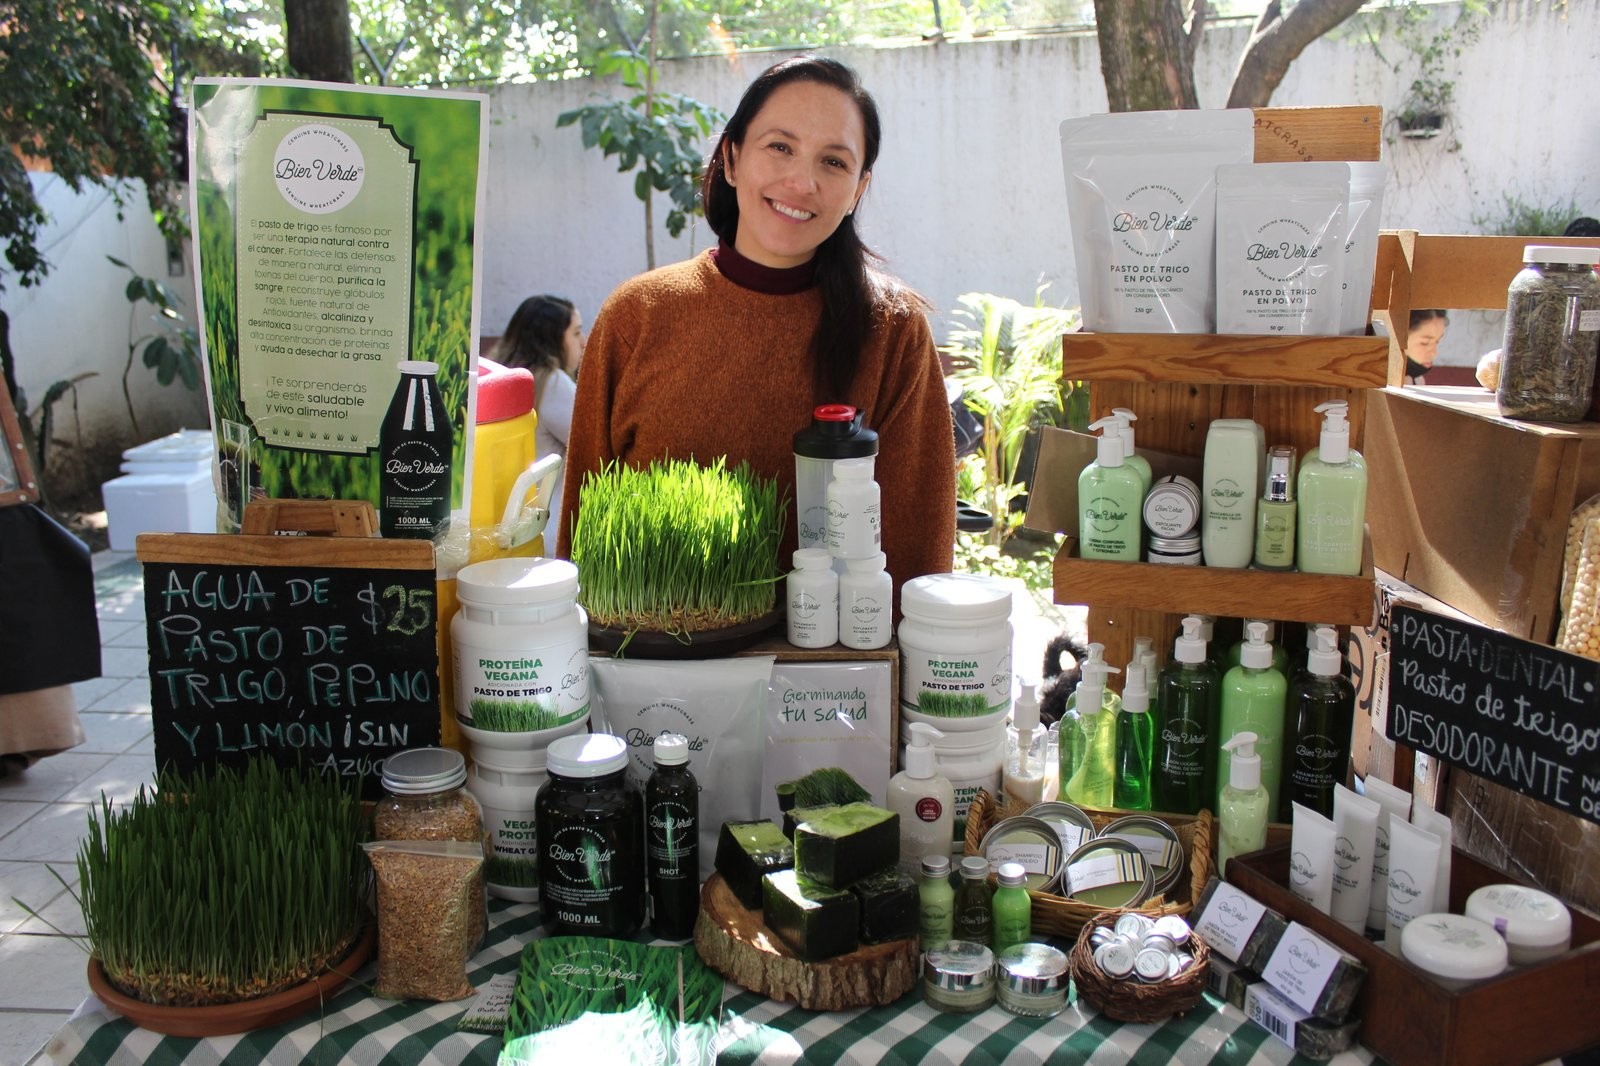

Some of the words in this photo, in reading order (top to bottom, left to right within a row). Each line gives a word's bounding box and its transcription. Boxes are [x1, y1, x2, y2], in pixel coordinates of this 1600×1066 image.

[1254, 118, 1313, 162] ATGRASS
[276, 158, 312, 180] Bien
[312, 159, 358, 181] Verde
[258, 220, 281, 230] pasto
[283, 221, 295, 230] de
[297, 222, 319, 232] trigo
[334, 224, 371, 235] famoso
[373, 227, 392, 236] por
[1113, 212, 1148, 232] Bien
[1149, 211, 1192, 231] Verde
[253, 233, 265, 241] ser
[285, 234, 318, 245] terapia
[320, 237, 355, 247] natural
[357, 239, 389, 249] contra
[289, 247, 332, 258] Fortalece
[334, 250, 348, 260] las
[350, 251, 396, 262] defensas
[1246, 243, 1280, 261] Bien
[258, 258, 269, 266] de
[271, 259, 306, 269] manera
[346, 263, 381, 274] elimina
[1110, 265, 1139, 273] PASTO
[1142, 265, 1156, 273] DE
[254, 269, 282, 280] toxinas
[283, 270, 297, 281] del
[337, 275, 374, 287] purifica
[376, 278, 386, 286] la
[1124, 275, 1136, 283] EN
[1139, 275, 1172, 283] POLVO
[286, 284, 341, 297] reconstruye
[289, 298, 317, 308] fuente
[319, 300, 354, 310] natural
[356, 301, 370, 311] de
[321, 312, 366, 323] alcaliniza
[368, 316, 374, 324] y
[248, 318, 291, 330] desintoxica
[292, 323, 302, 331] su
[360, 327, 392, 337] brinda
[249, 330, 264, 340] alta
[265, 332, 326, 345] concentración
[328, 336, 341, 346] de
[254, 344, 259, 352] y
[260, 344, 285, 354] ayuda
[295, 346, 338, 358] desechar
[340, 350, 350, 359] la
[352, 353, 383, 361] grasa.
[286, 379, 367, 394] sorprenderás
[266, 390, 280, 399] de
[282, 391, 305, 402] este
[307, 394, 364, 407] saludable
[266, 404, 272, 413] y
[274, 404, 294, 414] vivo
[297, 407, 348, 420] alimento!
[386, 460, 413, 474] Bien
[413, 460, 445, 474] Verde
[161, 570, 276, 611] AGUA
[286, 578, 330, 606] DE
[357, 582, 433, 635] $25
[157, 614, 283, 663] PASTO
[302, 625, 348, 655] DE
[479, 658, 543, 670] PROTEÍNA
[928, 660, 979, 669] PROTEÍNA
[484, 671, 539, 681] VEGANA
[932, 669, 975, 678] VEGANA
[307, 663, 430, 707] PEPINO
[474, 687, 504, 697] PASTO
[506, 689, 520, 697] DE
[522, 686, 552, 696] TRIGO
[922, 681, 947, 690] PASTO
[783, 686, 866, 703] Germinando
[782, 705, 806, 722] tu
[814, 701, 867, 722] salud
[1476, 683, 1505, 721] de
[1513, 694, 1600, 756] trigo
[172, 721, 200, 757] Y
[216, 709, 332, 752] LIMÓN
[1395, 704, 1574, 807] DESODORANTE
[503, 819, 536, 829] VEGA
[494, 845, 527, 854] WHEAT
[550, 844, 576, 862] Bien
[557, 910, 581, 924] 1000
[584, 915, 601, 924] ML
[550, 963, 591, 976] Bien
[592, 964, 637, 981] Verde
